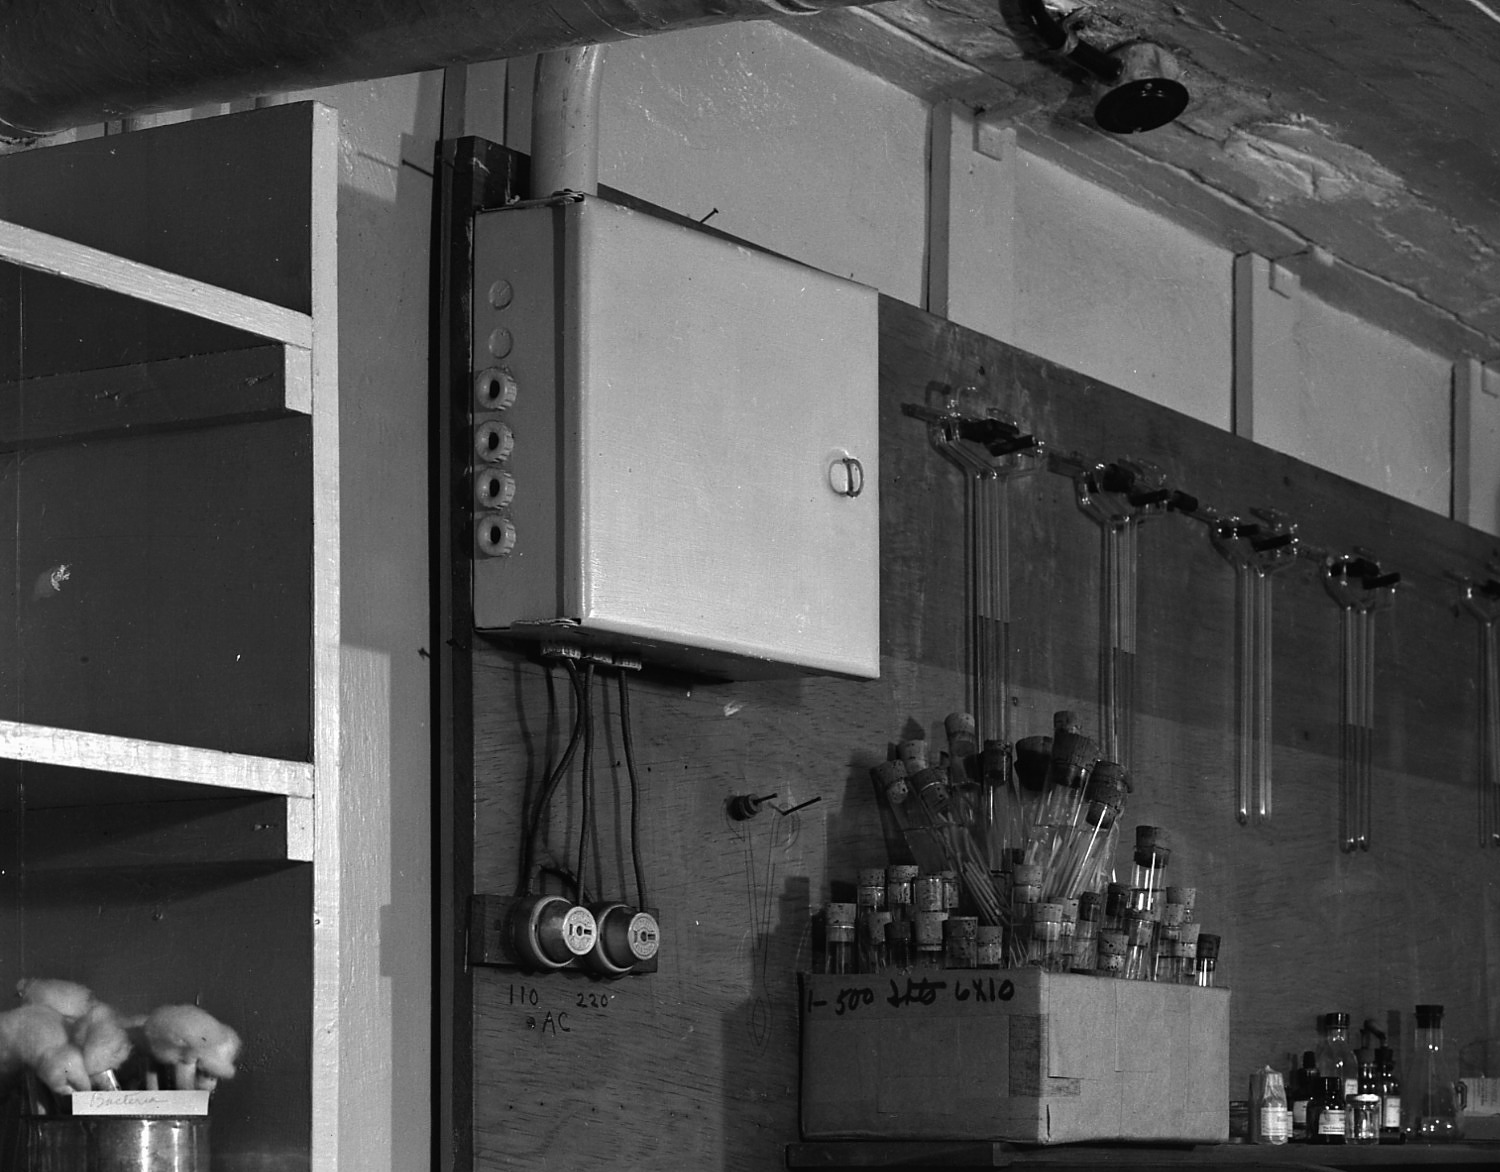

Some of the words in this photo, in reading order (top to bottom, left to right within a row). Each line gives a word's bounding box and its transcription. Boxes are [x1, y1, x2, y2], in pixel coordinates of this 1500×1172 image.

[509, 984, 539, 1005] 110
[576, 993, 608, 1008] 220
[835, 987, 874, 1015] 500
[542, 1011, 571, 1035] AC
